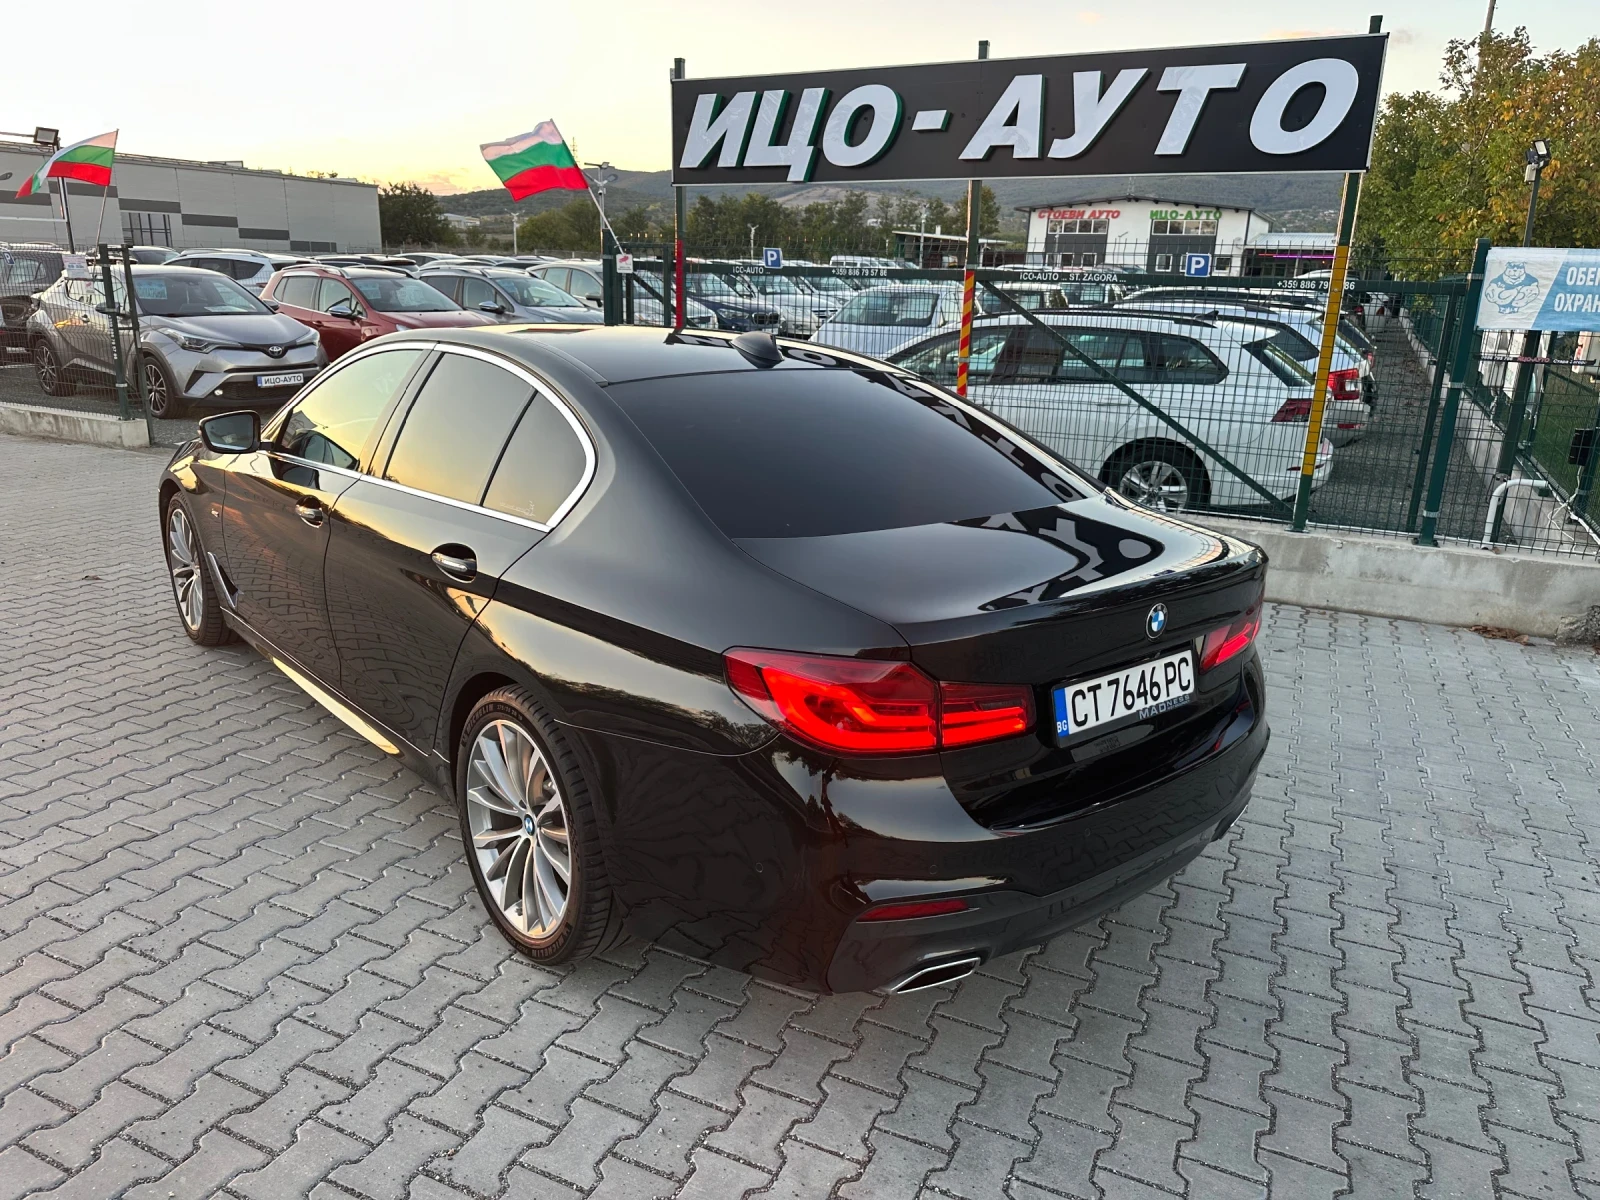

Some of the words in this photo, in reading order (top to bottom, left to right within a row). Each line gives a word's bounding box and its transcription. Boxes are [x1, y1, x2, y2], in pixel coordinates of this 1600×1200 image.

[1038, 210, 1087, 219] СТОЕВИ
[1088, 210, 1121, 219] АУТО
[1150, 210, 1222, 220] ИЦО-АУТО
[831, 268, 847, 277] +359
[861, 268, 870, 277] 79
[870, 268, 879, 277] 57
[1082, 273, 1118, 282] ZAGORA
[1277, 279, 1298, 289] +359
[1300, 281, 1316, 289] 886
[1318, 281, 1328, 289] 79
[264, 375, 302, 385] ИЦО-АУТО
[1056, 719, 1068, 734] BG
[1071, 683, 1103, 727] CT
[1106, 665, 1162, 717] 7646
[1163, 656, 1191, 698] PC
[1138, 694, 1191, 720] MADNESS
